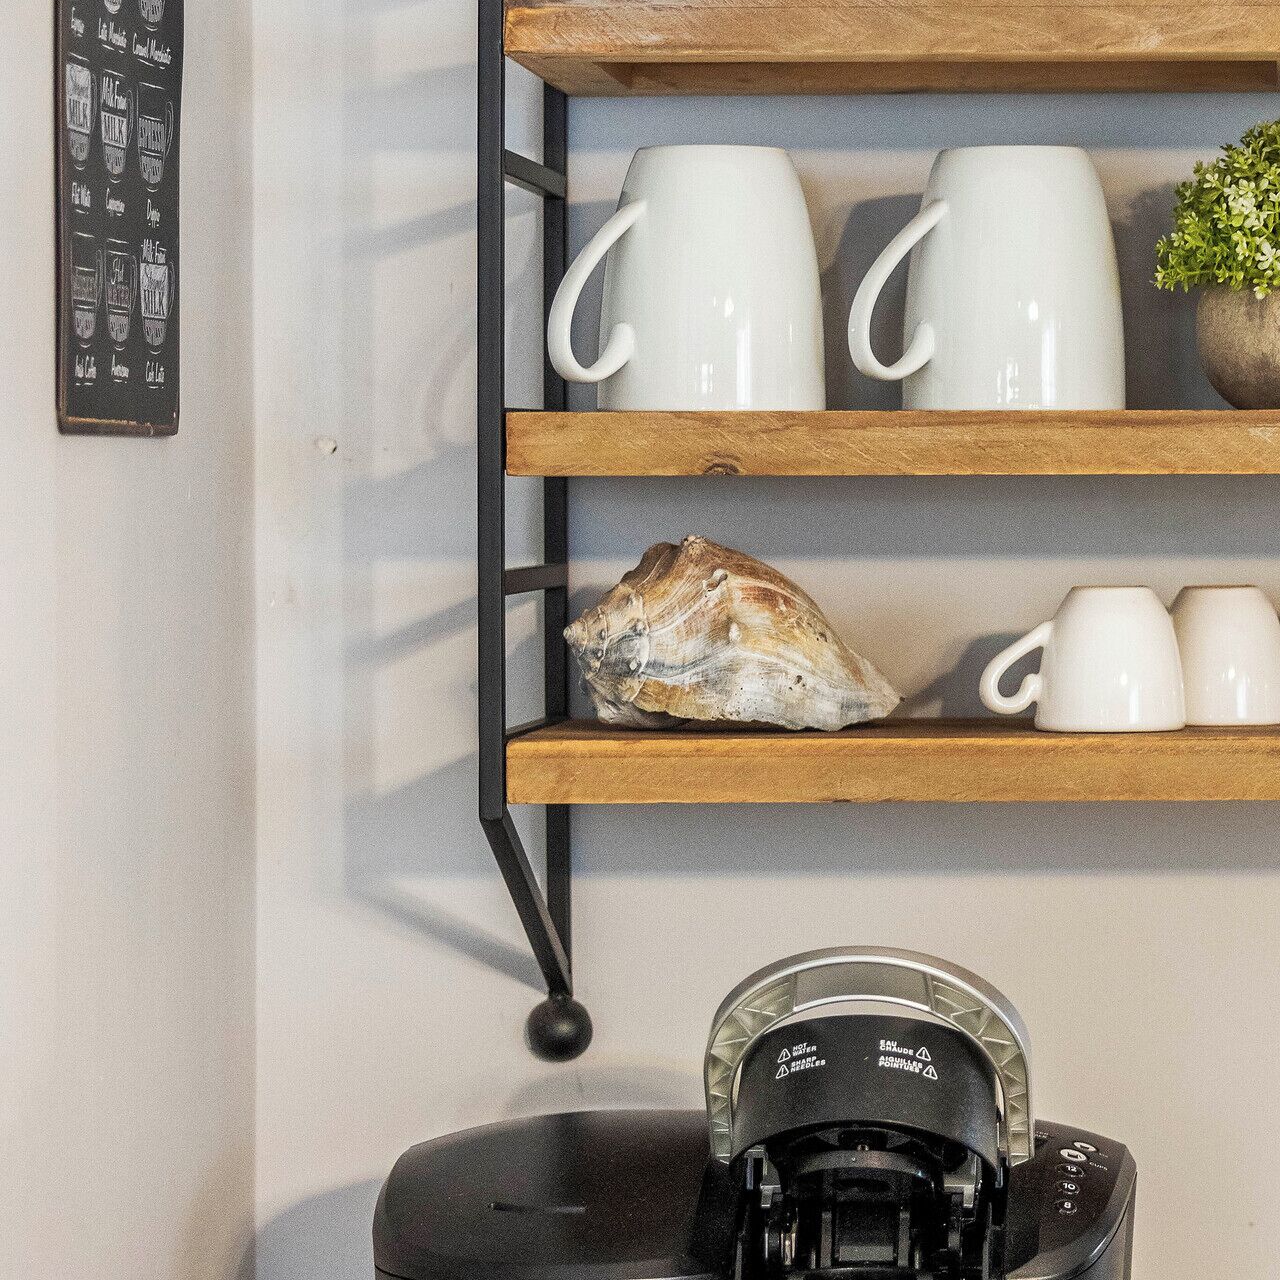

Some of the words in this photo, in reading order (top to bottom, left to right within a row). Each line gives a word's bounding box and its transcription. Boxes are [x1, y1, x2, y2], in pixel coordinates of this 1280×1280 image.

[792, 1042, 808, 1052] HOT
[879, 1039, 898, 1048] EAU
[792, 1045, 817, 1057] WATER
[879, 1045, 914, 1056] CHAUDE
[790, 1056, 817, 1068] SHARP
[790, 1059, 826, 1073] NEEDLES
[879, 1055, 923, 1069] AIGUILLES
[879, 1061, 920, 1073] POINTUES
[1065, 1165, 1077, 1173] 12
[1062, 1182, 1076, 1190] 10
[1063, 1201, 1072, 1209] 8
